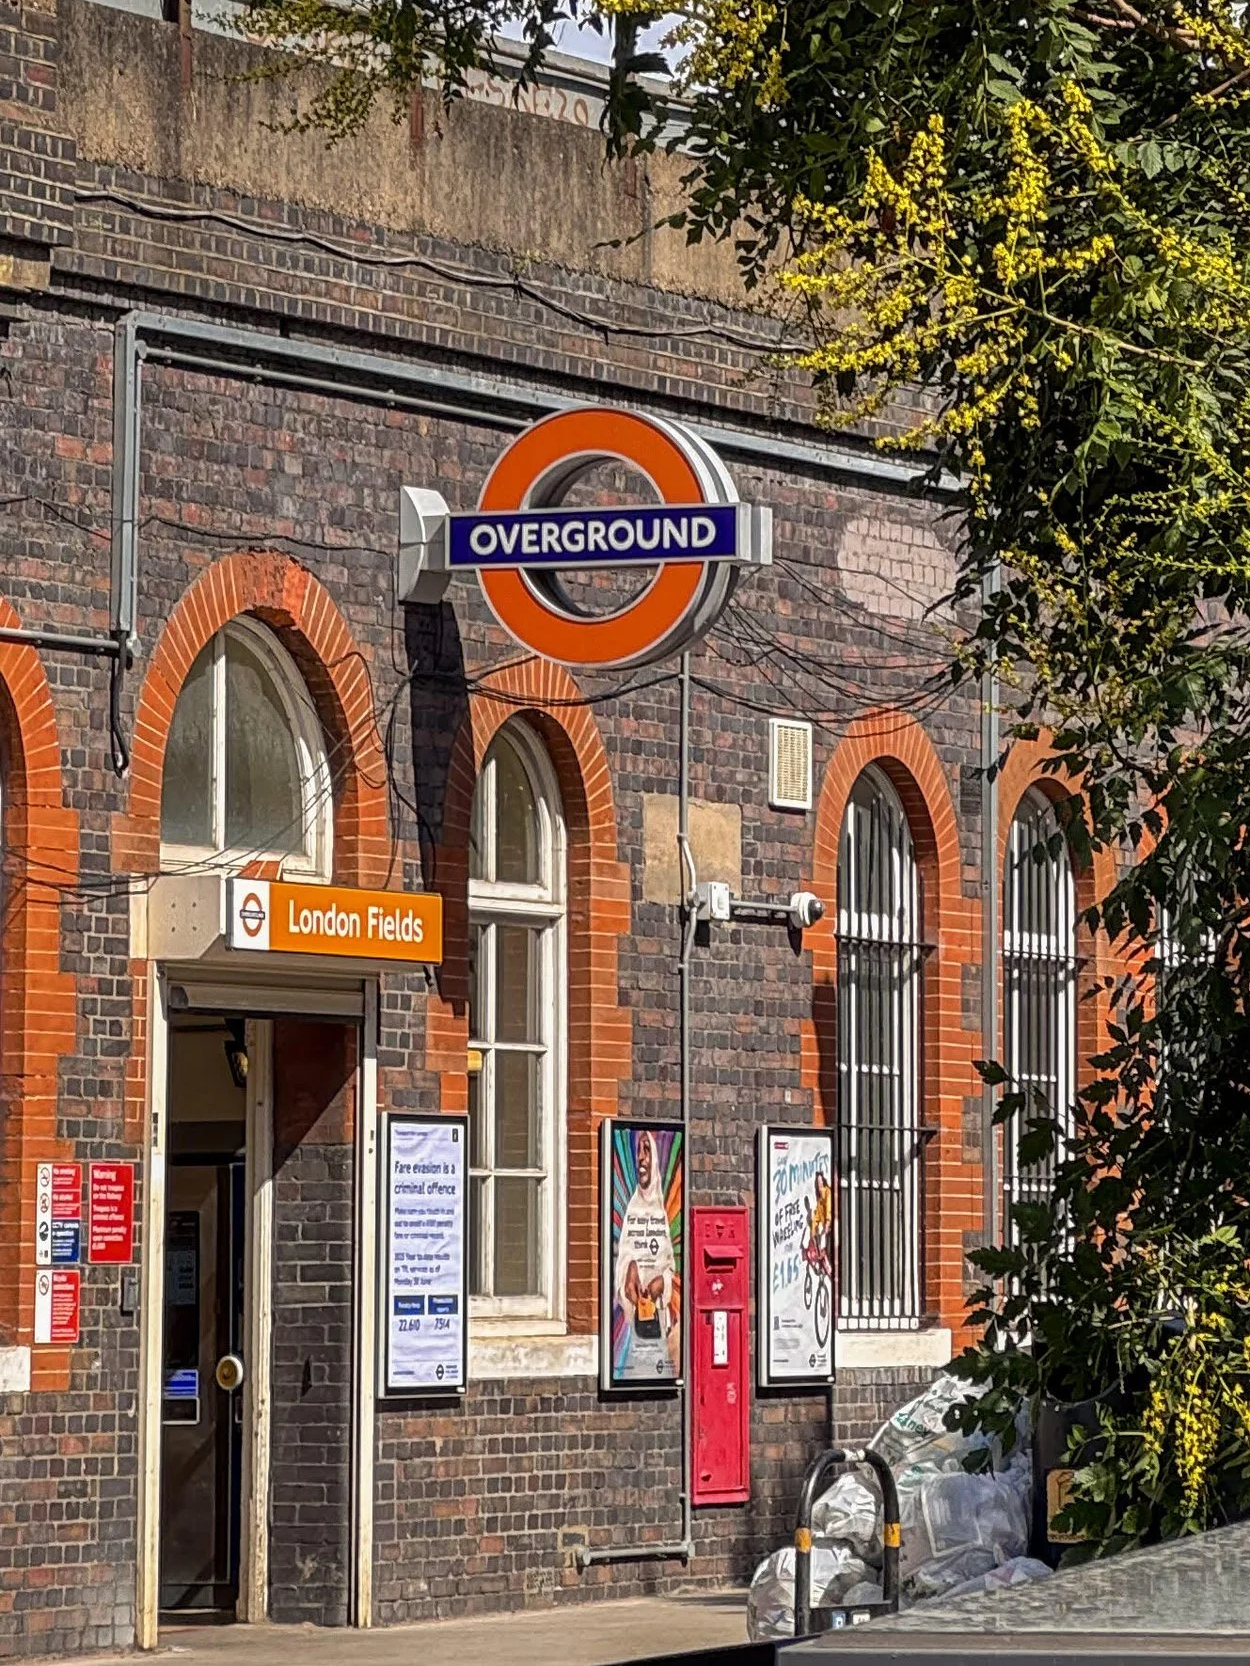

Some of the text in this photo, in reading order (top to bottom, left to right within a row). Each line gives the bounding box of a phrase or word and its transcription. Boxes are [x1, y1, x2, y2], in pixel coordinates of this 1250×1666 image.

[470, 516, 716, 556] OVERGROUND
[288, 899, 424, 943] London Fields
[394, 1161, 456, 1174] Fare evasion is a
[394, 1182, 456, 1194] criminal offence
[775, 1199, 800, 1226] OF FREE
